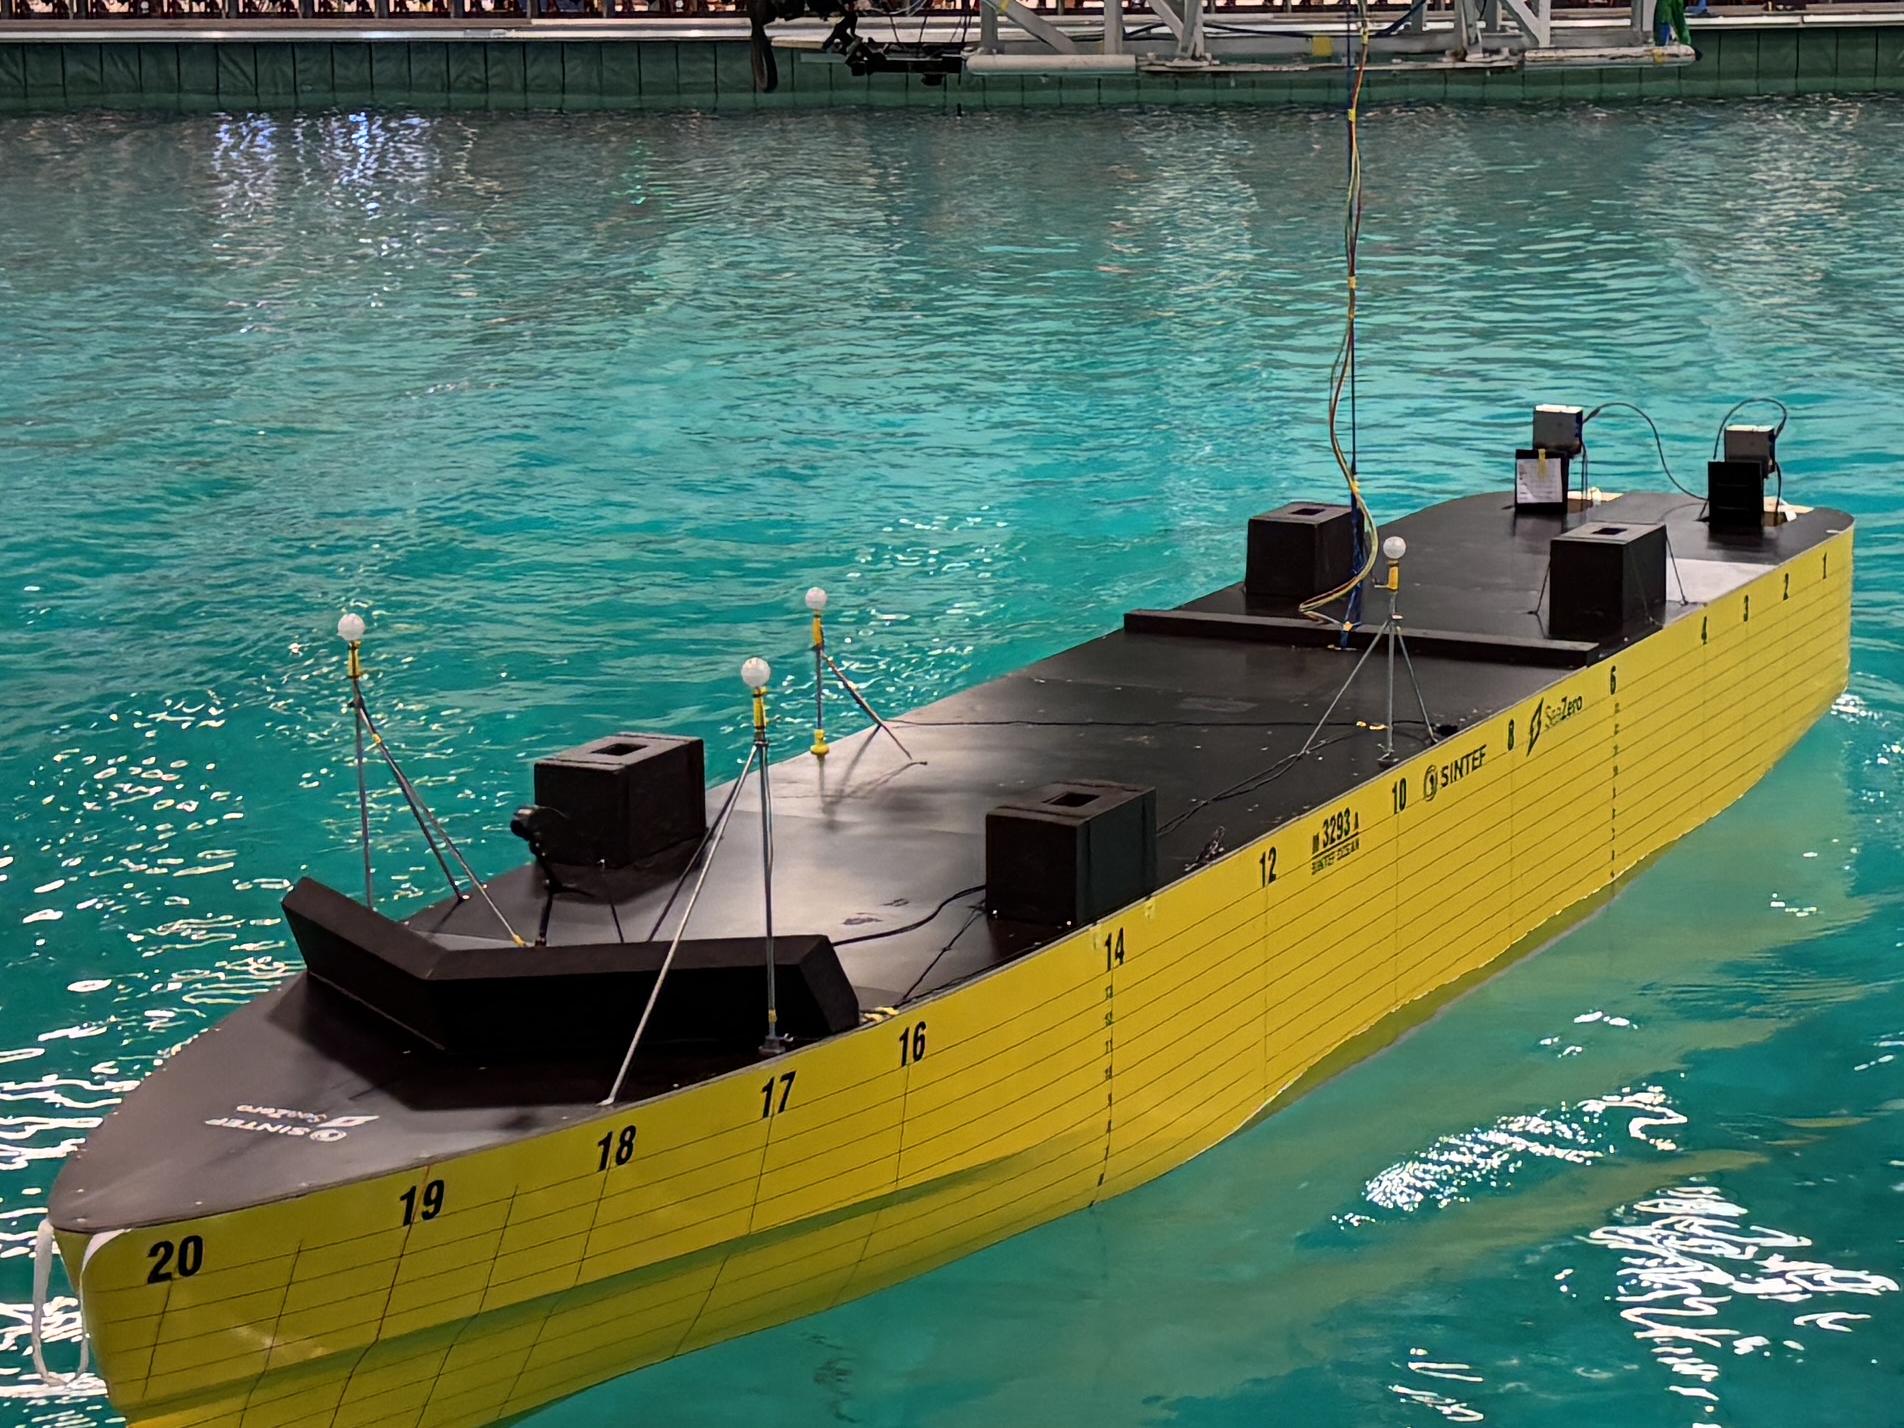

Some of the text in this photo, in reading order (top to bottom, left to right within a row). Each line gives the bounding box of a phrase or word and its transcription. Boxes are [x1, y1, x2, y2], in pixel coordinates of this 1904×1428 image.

[1782, 572, 1790, 601] 2
[1821, 552, 1828, 580] 1
[1609, 664, 1617, 696] 6
[1506, 718, 1516, 751] 8
[1439, 744, 1487, 789] SINTEF
[1391, 777, 1408, 815] 10
[1322, 806, 1351, 849] 3293
[1258, 846, 1278, 888] 12
[1104, 927, 1125, 973] 14
[898, 1021, 928, 1069] 16
[760, 1070, 798, 1120] 17
[205, 1117, 311, 1136] SINTEF
[596, 1124, 637, 1173] 18
[399, 1179, 445, 1228] 19
[143, 1234, 204, 1286] 20
